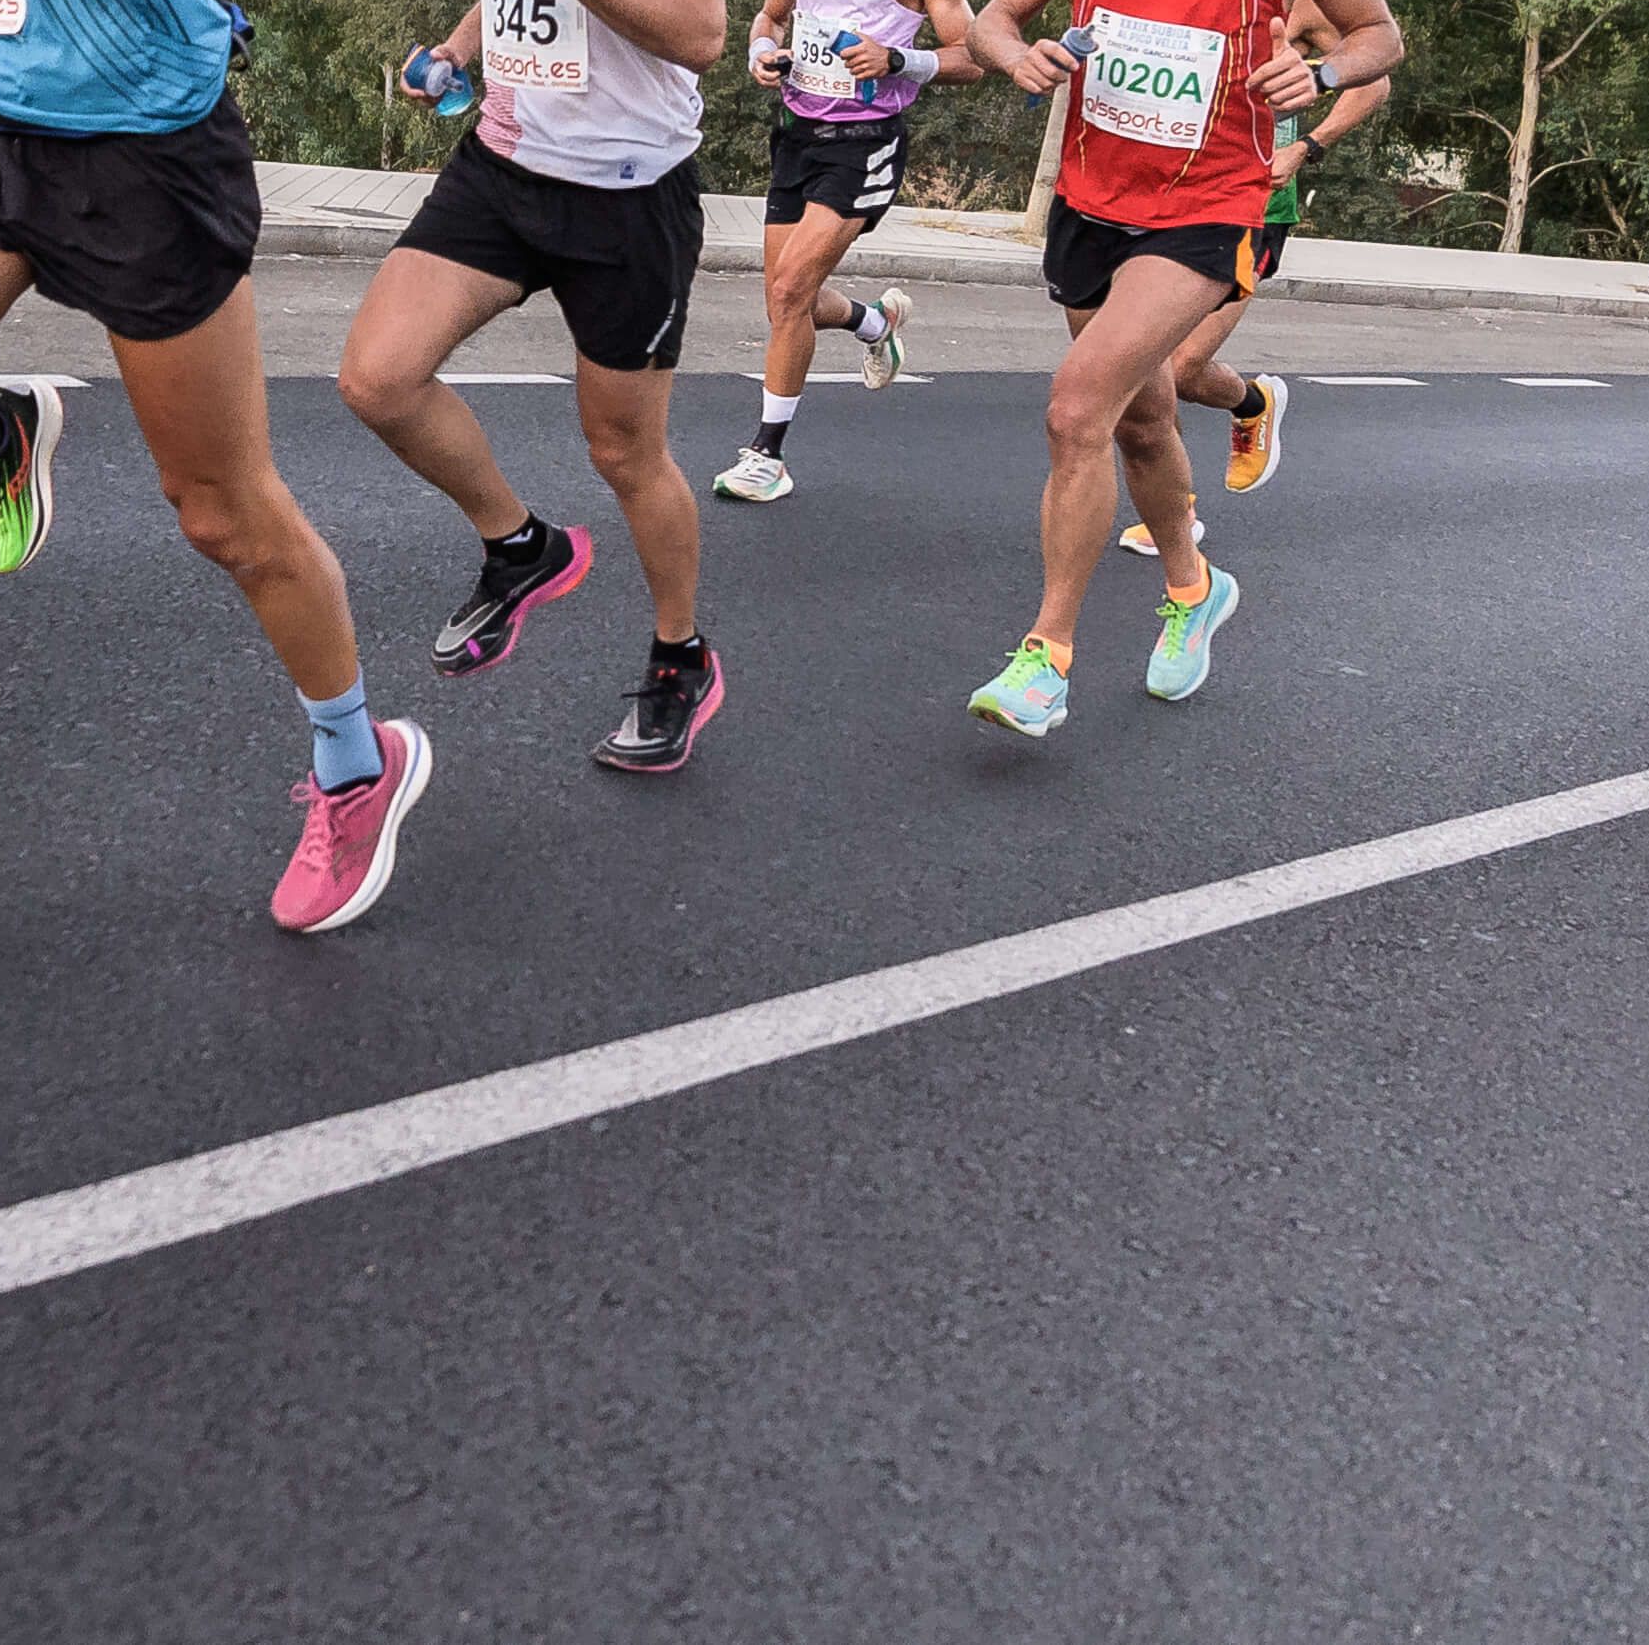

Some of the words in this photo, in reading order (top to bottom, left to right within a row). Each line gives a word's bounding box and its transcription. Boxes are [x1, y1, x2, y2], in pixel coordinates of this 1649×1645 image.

[1129, 32, 1152, 45] PICO
[1155, 36, 1189, 51] VELETA
[1152, 23, 1191, 39] SUBIDA
[801, 40, 834, 67] 395
[1095, 52, 1202, 104] 1020A
[1085, 95, 1198, 137] alssport.es
